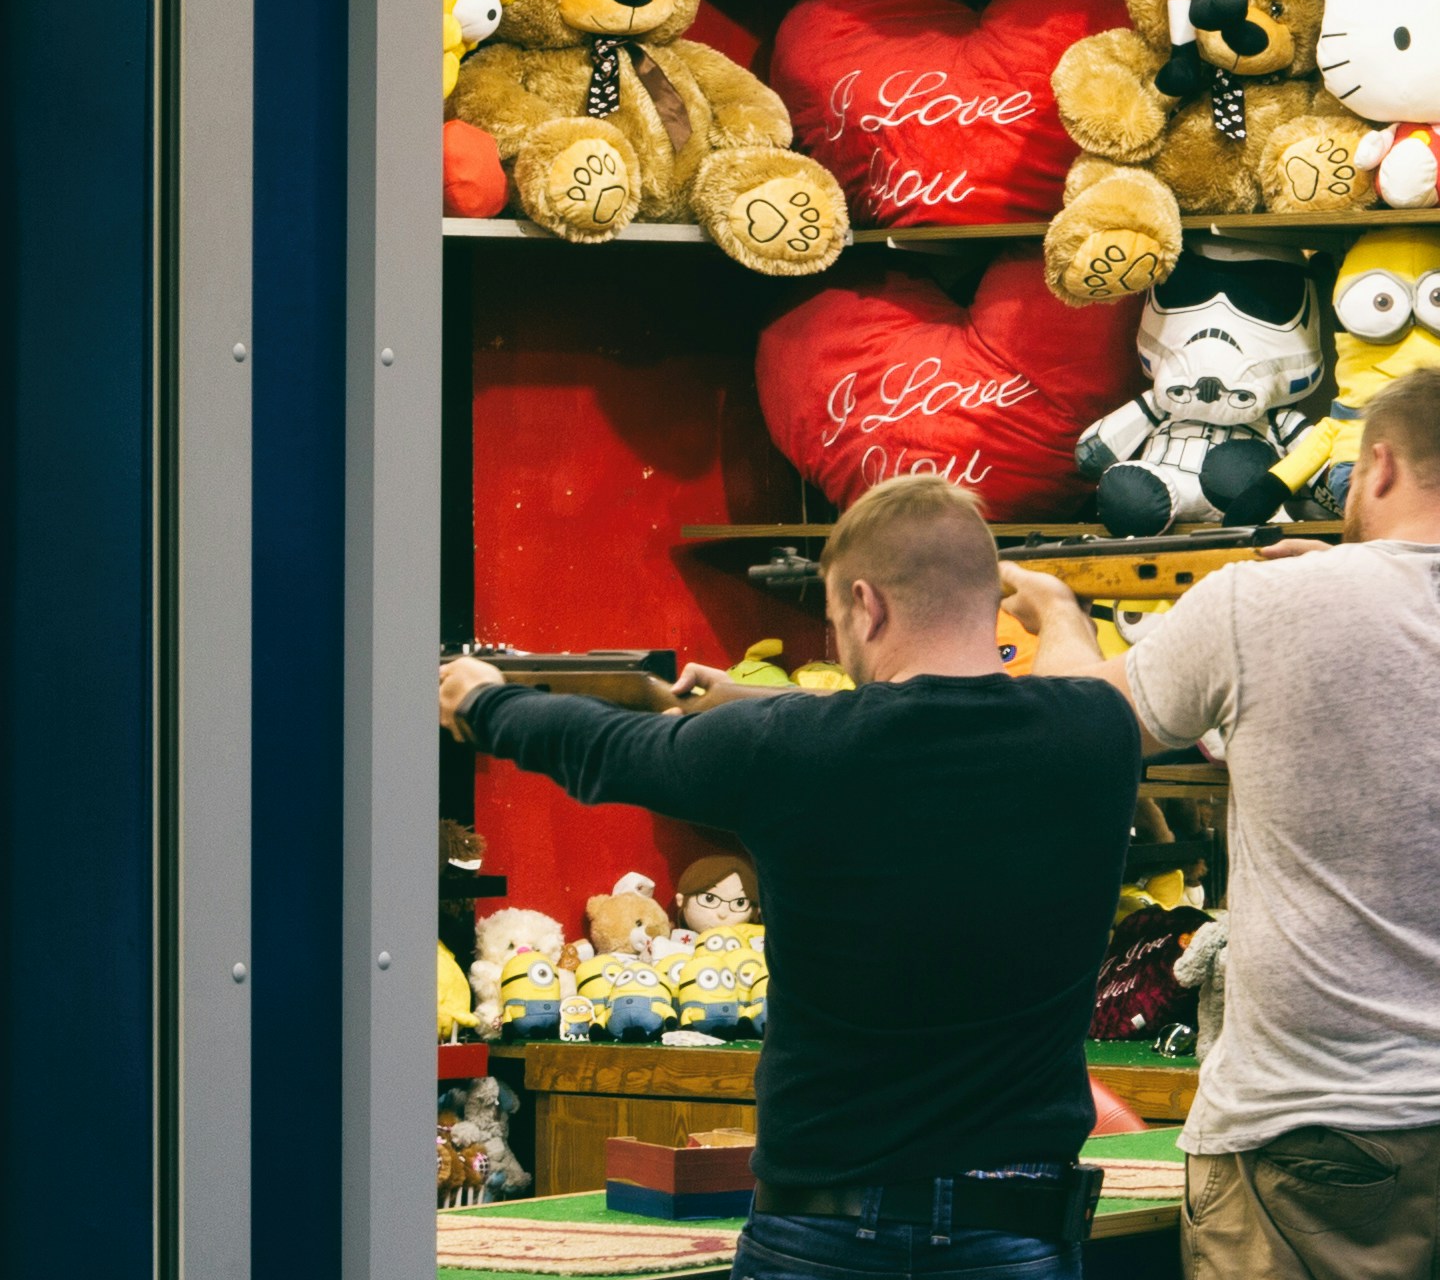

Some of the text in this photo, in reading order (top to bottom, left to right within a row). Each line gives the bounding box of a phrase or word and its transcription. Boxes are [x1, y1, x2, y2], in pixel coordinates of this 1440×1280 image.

[826, 69, 1036, 141] I Love
[868, 147, 975, 215] You
[822, 357, 1038, 447] I Love
